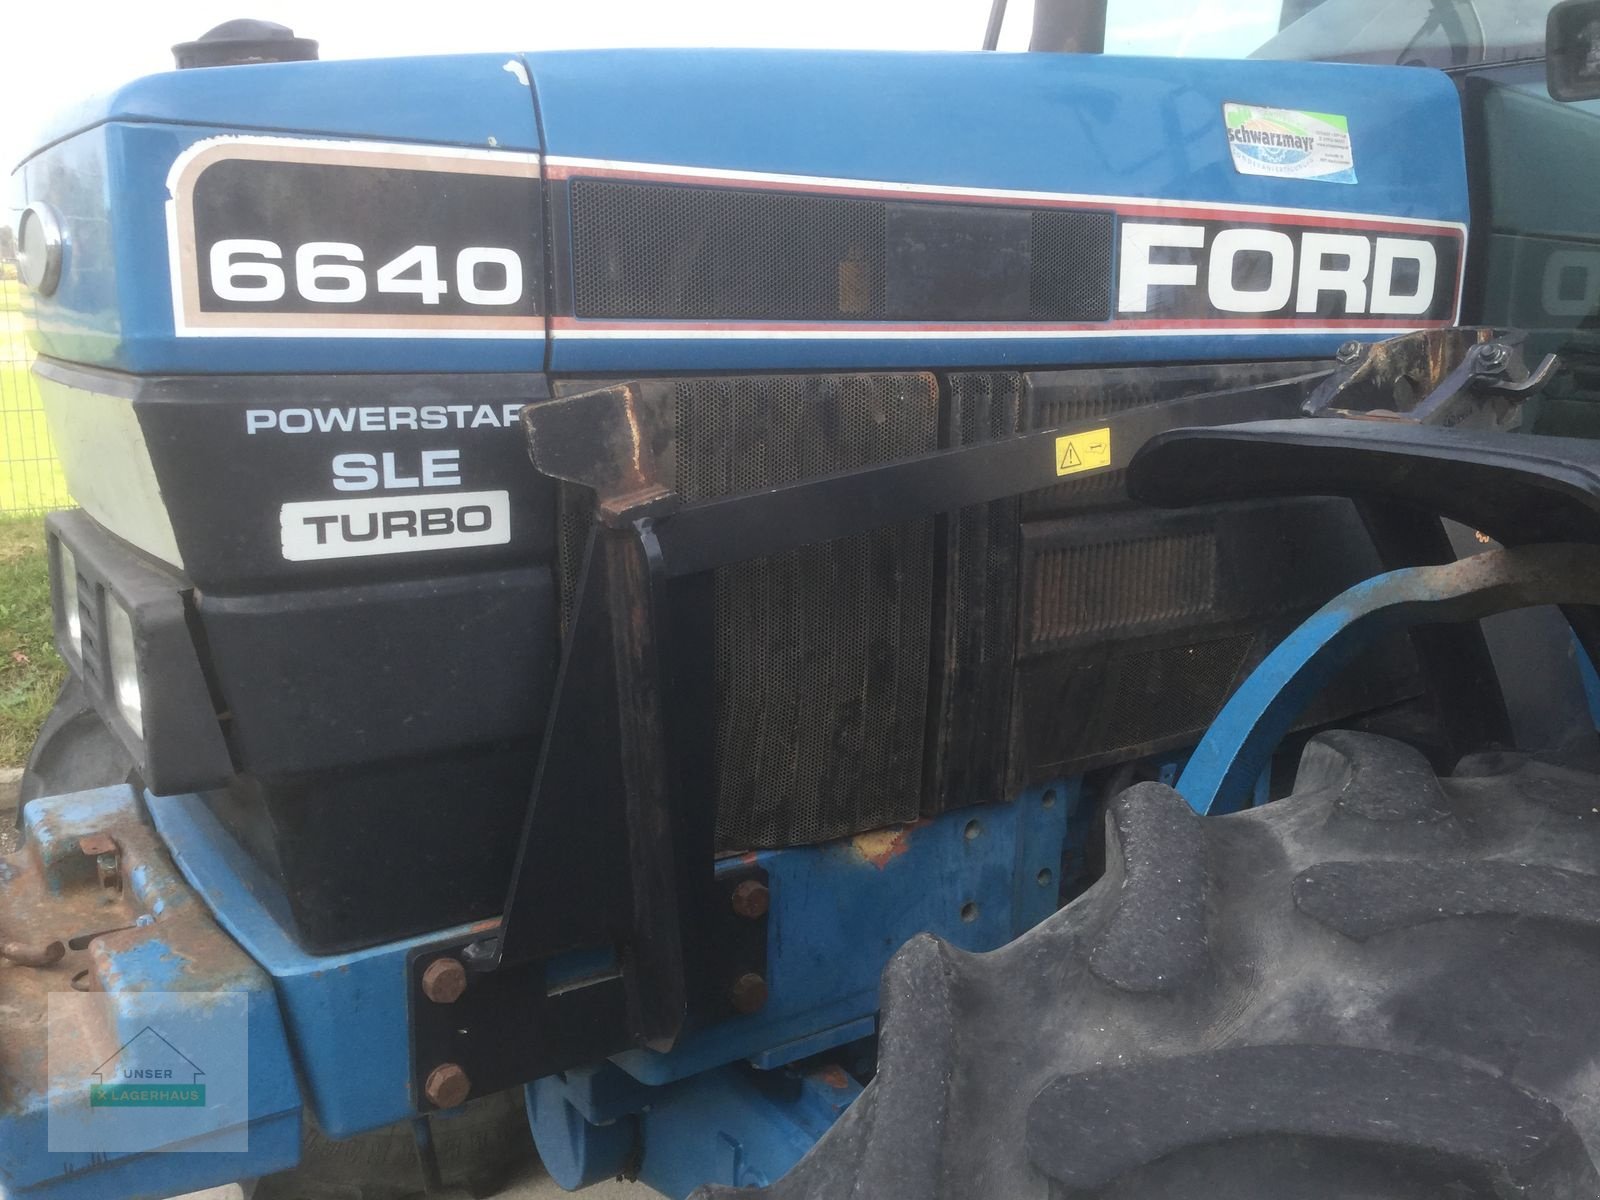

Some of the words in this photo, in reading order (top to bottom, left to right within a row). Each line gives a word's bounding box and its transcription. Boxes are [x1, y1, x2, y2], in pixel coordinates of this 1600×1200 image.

[1228, 125, 1314, 151] schwarzmayr
[209, 239, 523, 306] 6640
[1118, 222, 1437, 314] FORD
[332, 450, 462, 491] SLE
[303, 505, 492, 545] TURBO
